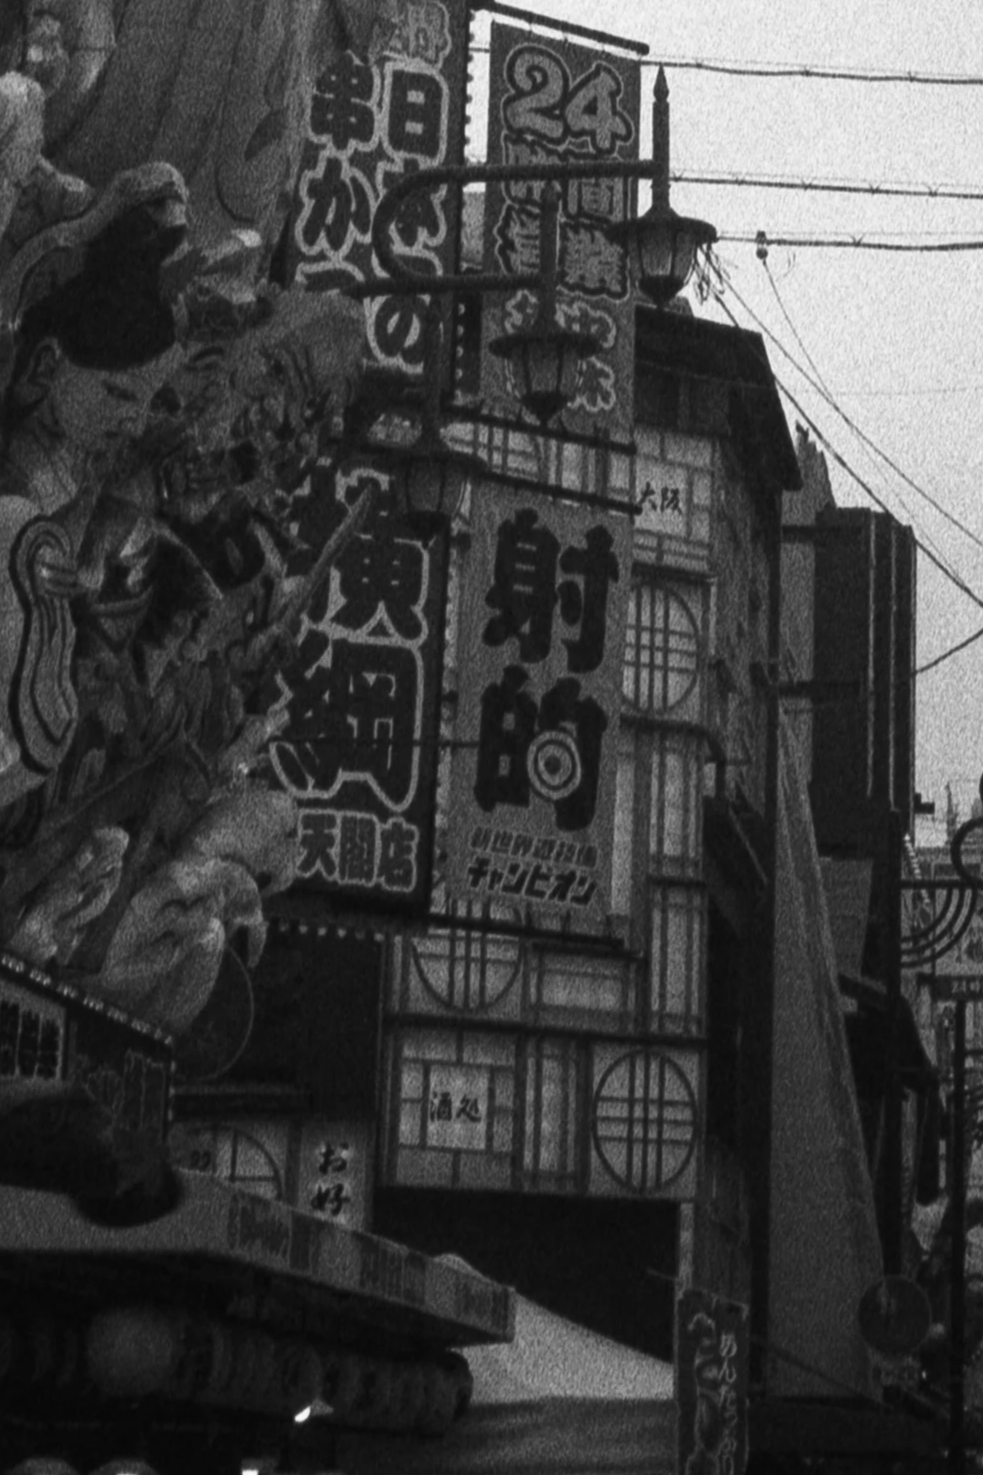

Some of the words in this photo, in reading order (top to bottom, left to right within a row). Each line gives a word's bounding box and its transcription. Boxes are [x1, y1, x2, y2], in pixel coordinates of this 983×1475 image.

[504, 43, 633, 154] 24
[637, 482, 683, 514] 大阪
[477, 508, 618, 832] 射的
[467, 856, 598, 906] チャンピオン
[429, 1091, 484, 1125] 酒処
[310, 1140, 352, 1217] お好
